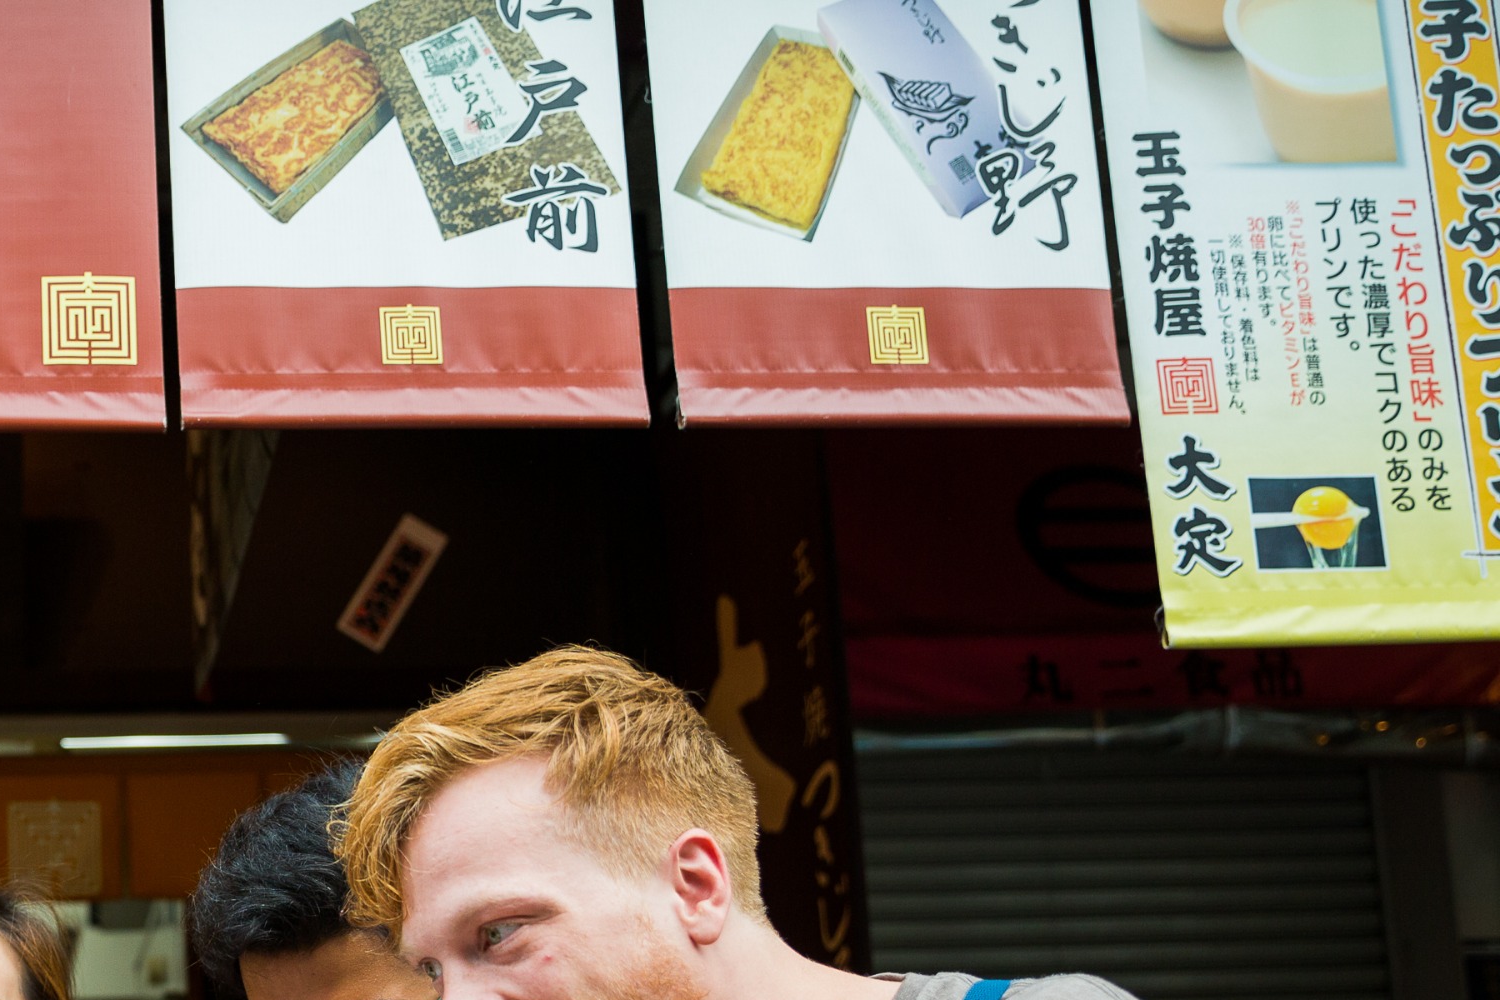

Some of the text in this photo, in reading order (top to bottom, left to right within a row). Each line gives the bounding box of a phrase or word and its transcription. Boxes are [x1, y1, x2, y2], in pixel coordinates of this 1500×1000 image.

[978, 0, 1078, 251] きじ野
[1132, 131, 1206, 337] 玉子焼屋
[1314, 197, 1360, 352] プリンです。
[1350, 197, 1416, 512] 使った濃厚でコクのある
[1390, 198, 1452, 511] 「こだわり旨味」のみを
[1167, 436, 1240, 573] 大定
